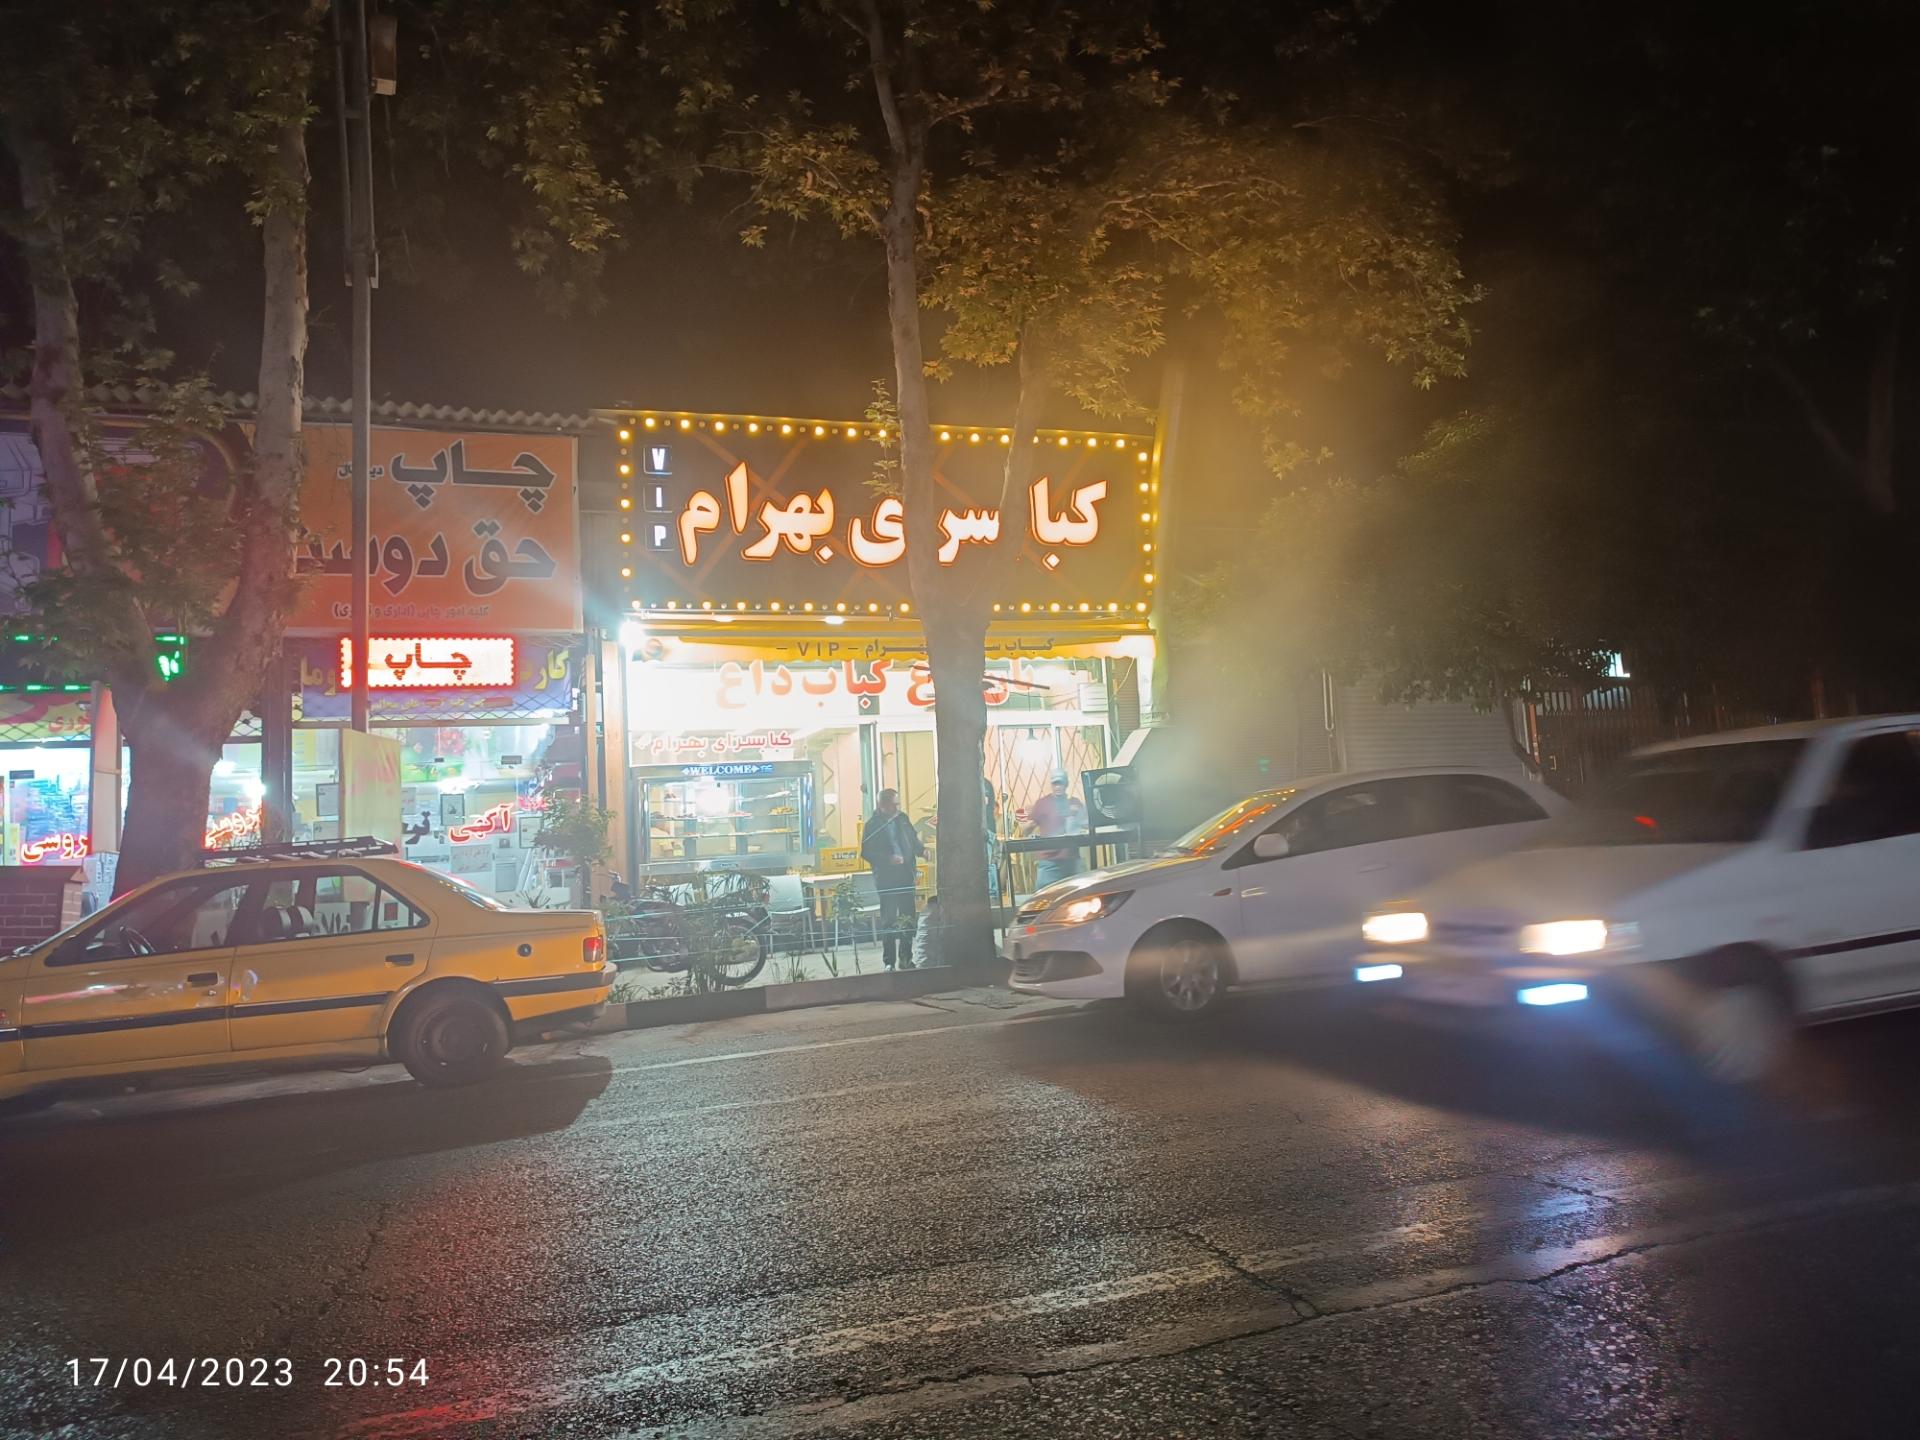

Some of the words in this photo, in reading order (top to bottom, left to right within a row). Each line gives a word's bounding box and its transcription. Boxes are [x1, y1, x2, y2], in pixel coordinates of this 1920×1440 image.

[390, 438, 557, 513] چاپ
[677, 460, 835, 567] بهرام
[463, 519, 558, 597] حق
[384, 643, 473, 680] چاپ
[797, 641, 840, 657] VIP
[1005, 638, 1055, 656] کباب
[689, 764, 753, 776] WELCOME
